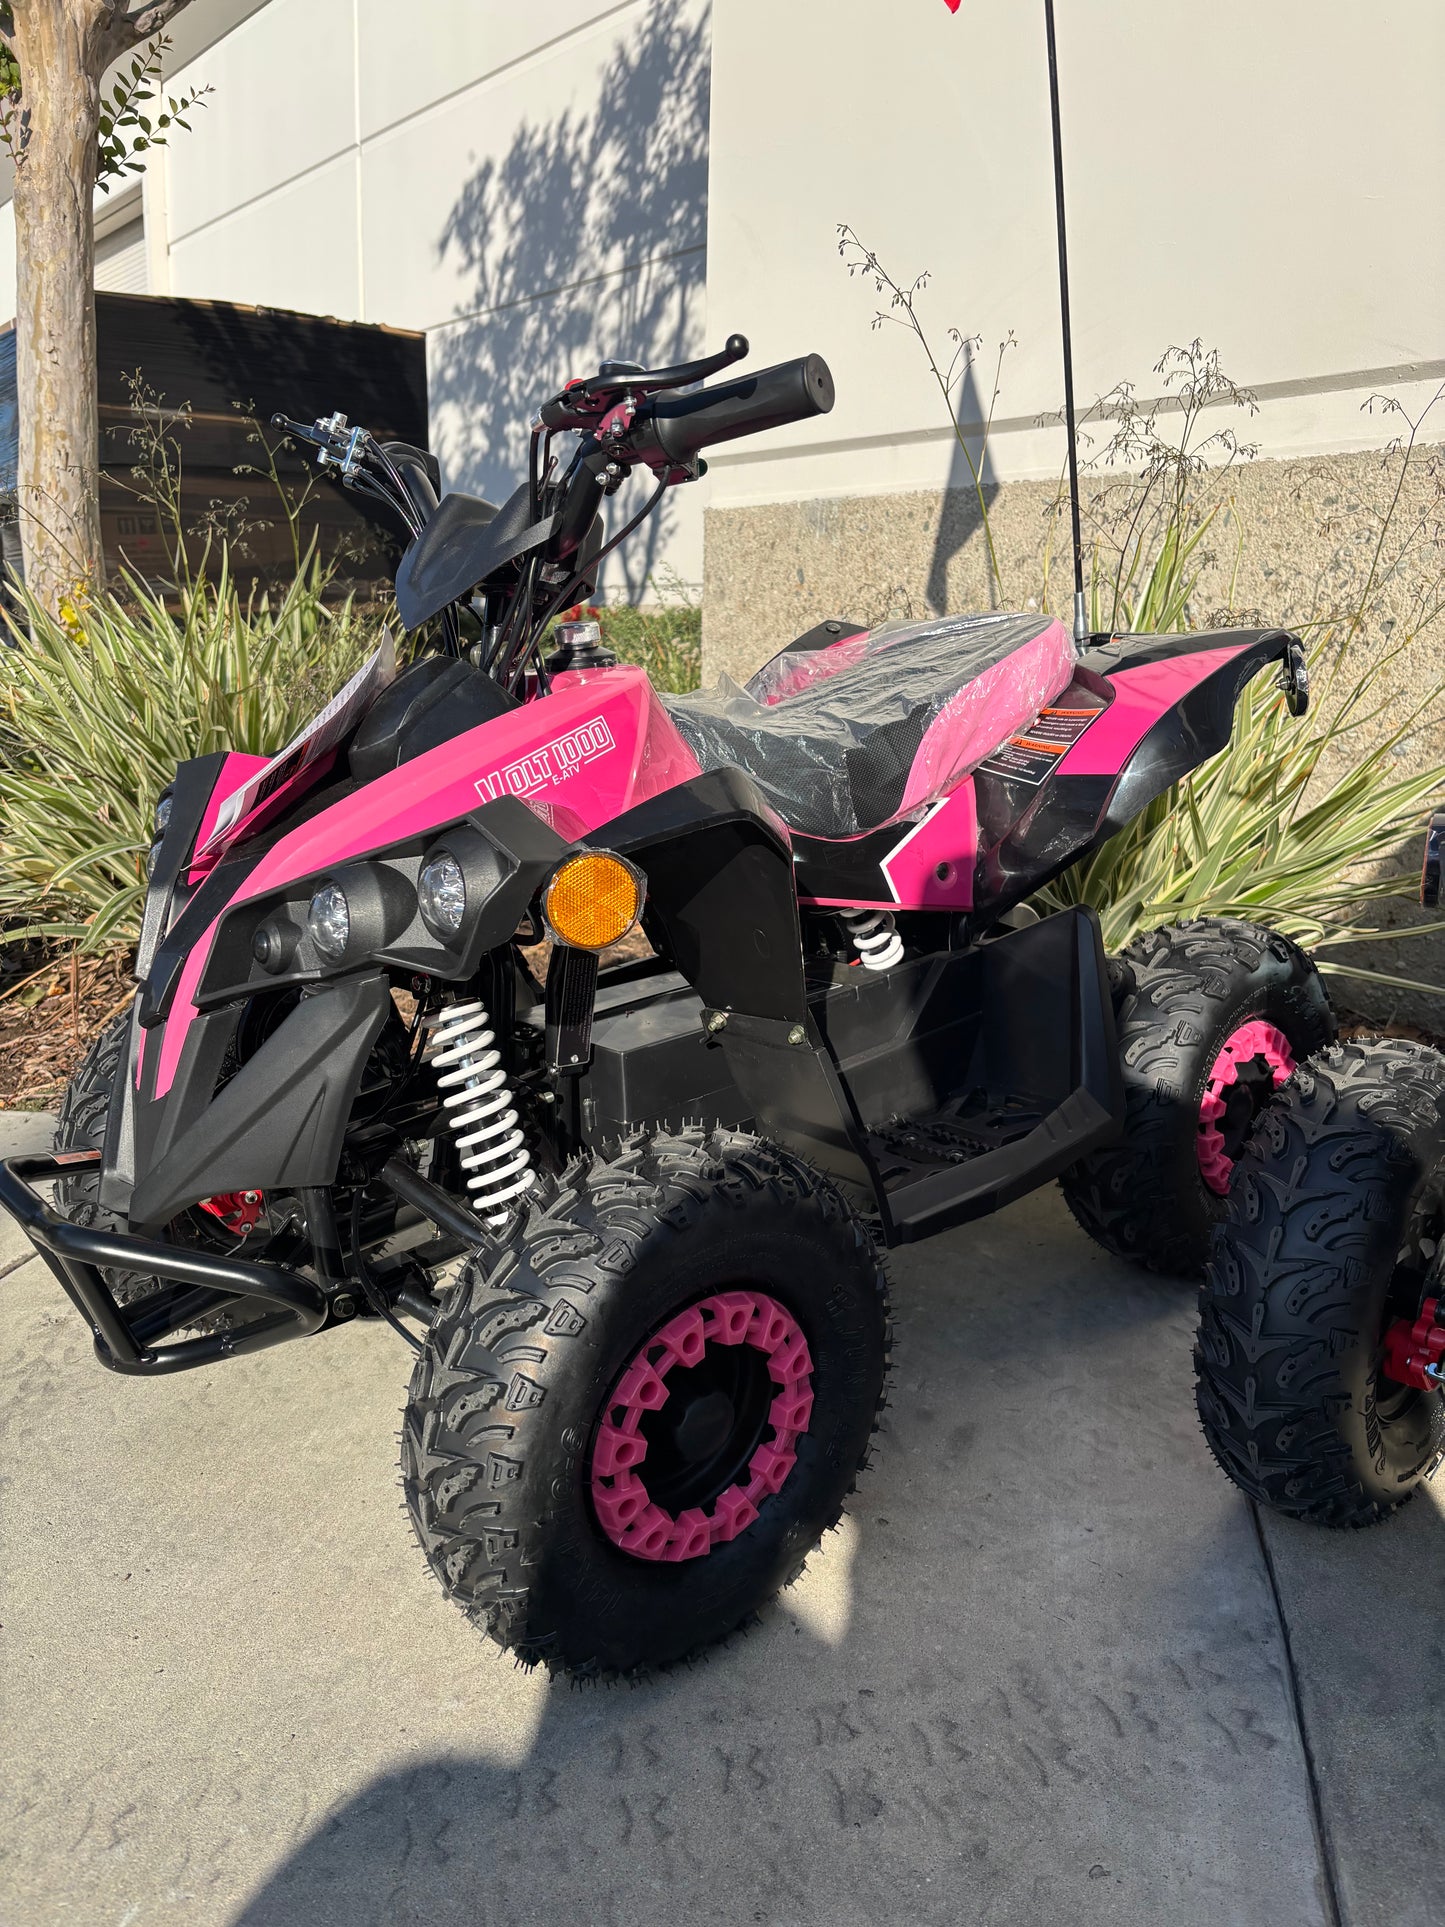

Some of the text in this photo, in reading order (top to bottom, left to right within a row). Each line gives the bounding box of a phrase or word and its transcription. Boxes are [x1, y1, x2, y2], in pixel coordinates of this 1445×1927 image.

[474, 721, 610, 804] VOLT 1000
[552, 763, 581, 786] E-ATV
